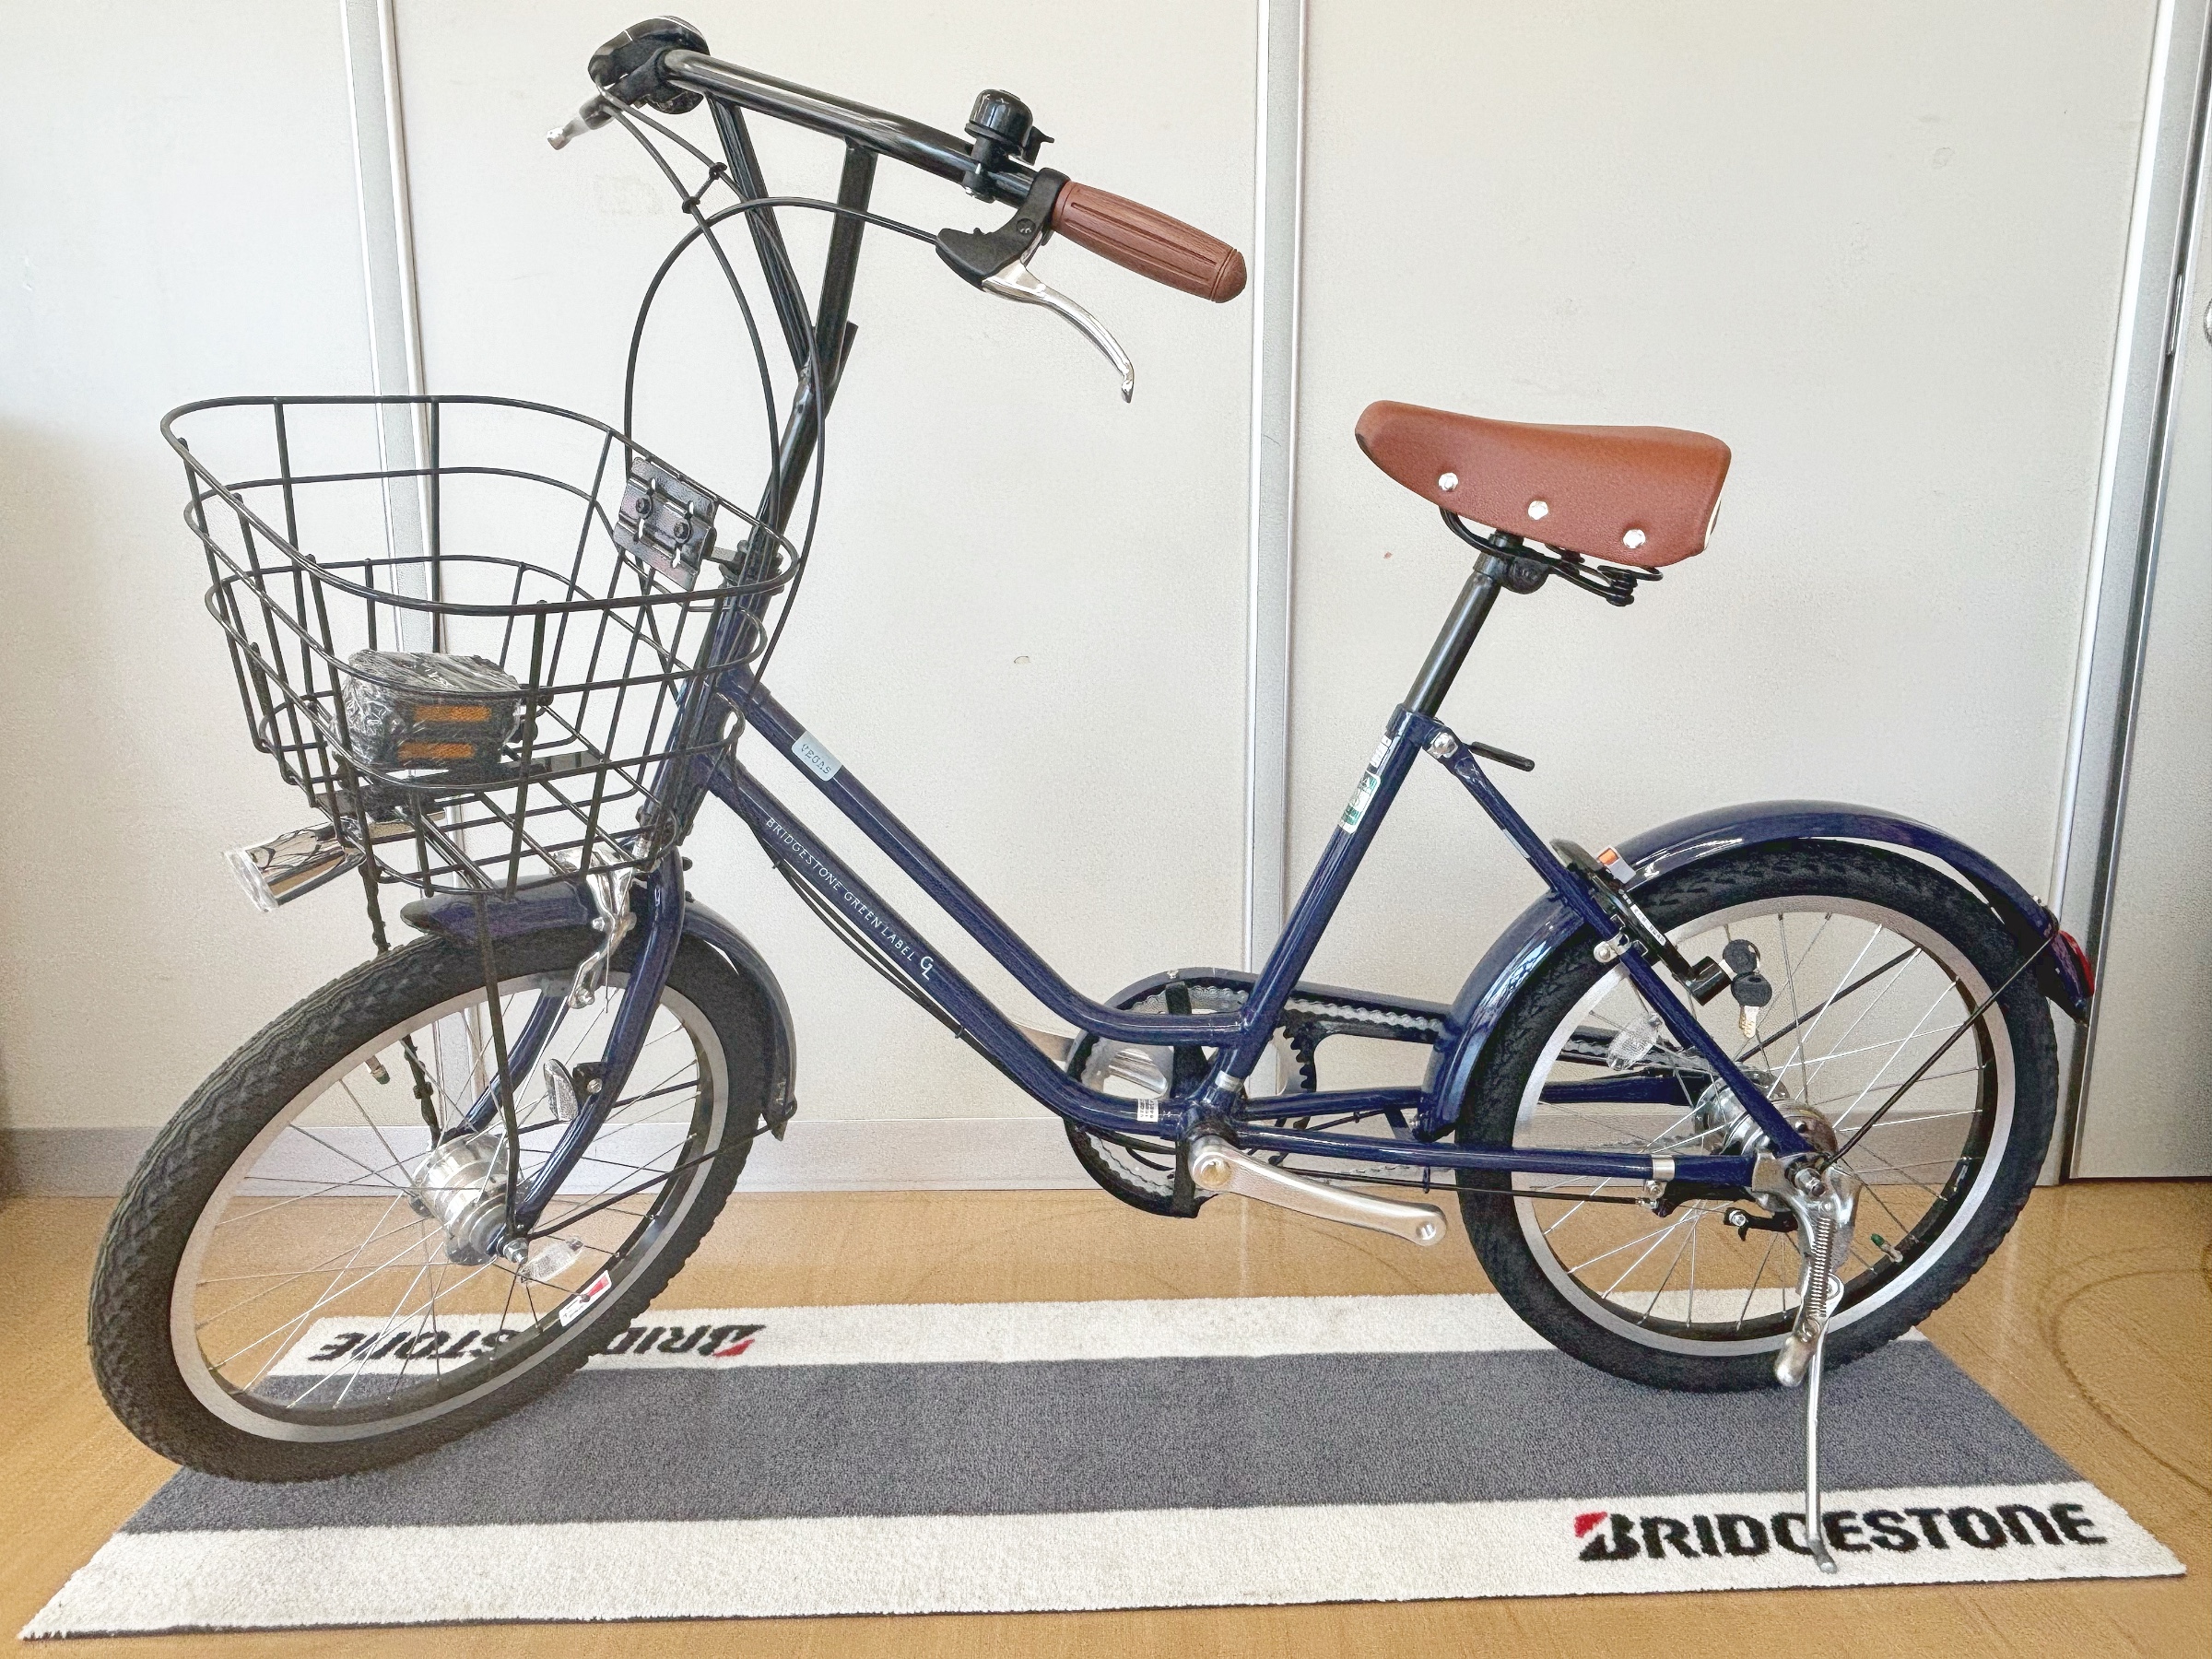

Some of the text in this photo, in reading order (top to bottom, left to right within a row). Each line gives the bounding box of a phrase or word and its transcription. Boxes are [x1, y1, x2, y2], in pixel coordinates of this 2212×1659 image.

[801, 743, 831, 774] VEGAS
[766, 818, 841, 891] BRIDGESTONE
[844, 891, 882, 928] GREEN
[881, 926, 915, 961] LABEL
[308, 1324, 767, 1360] BRIDSTONE
[1574, 1502, 2107, 1561] BRIDGESTONE
